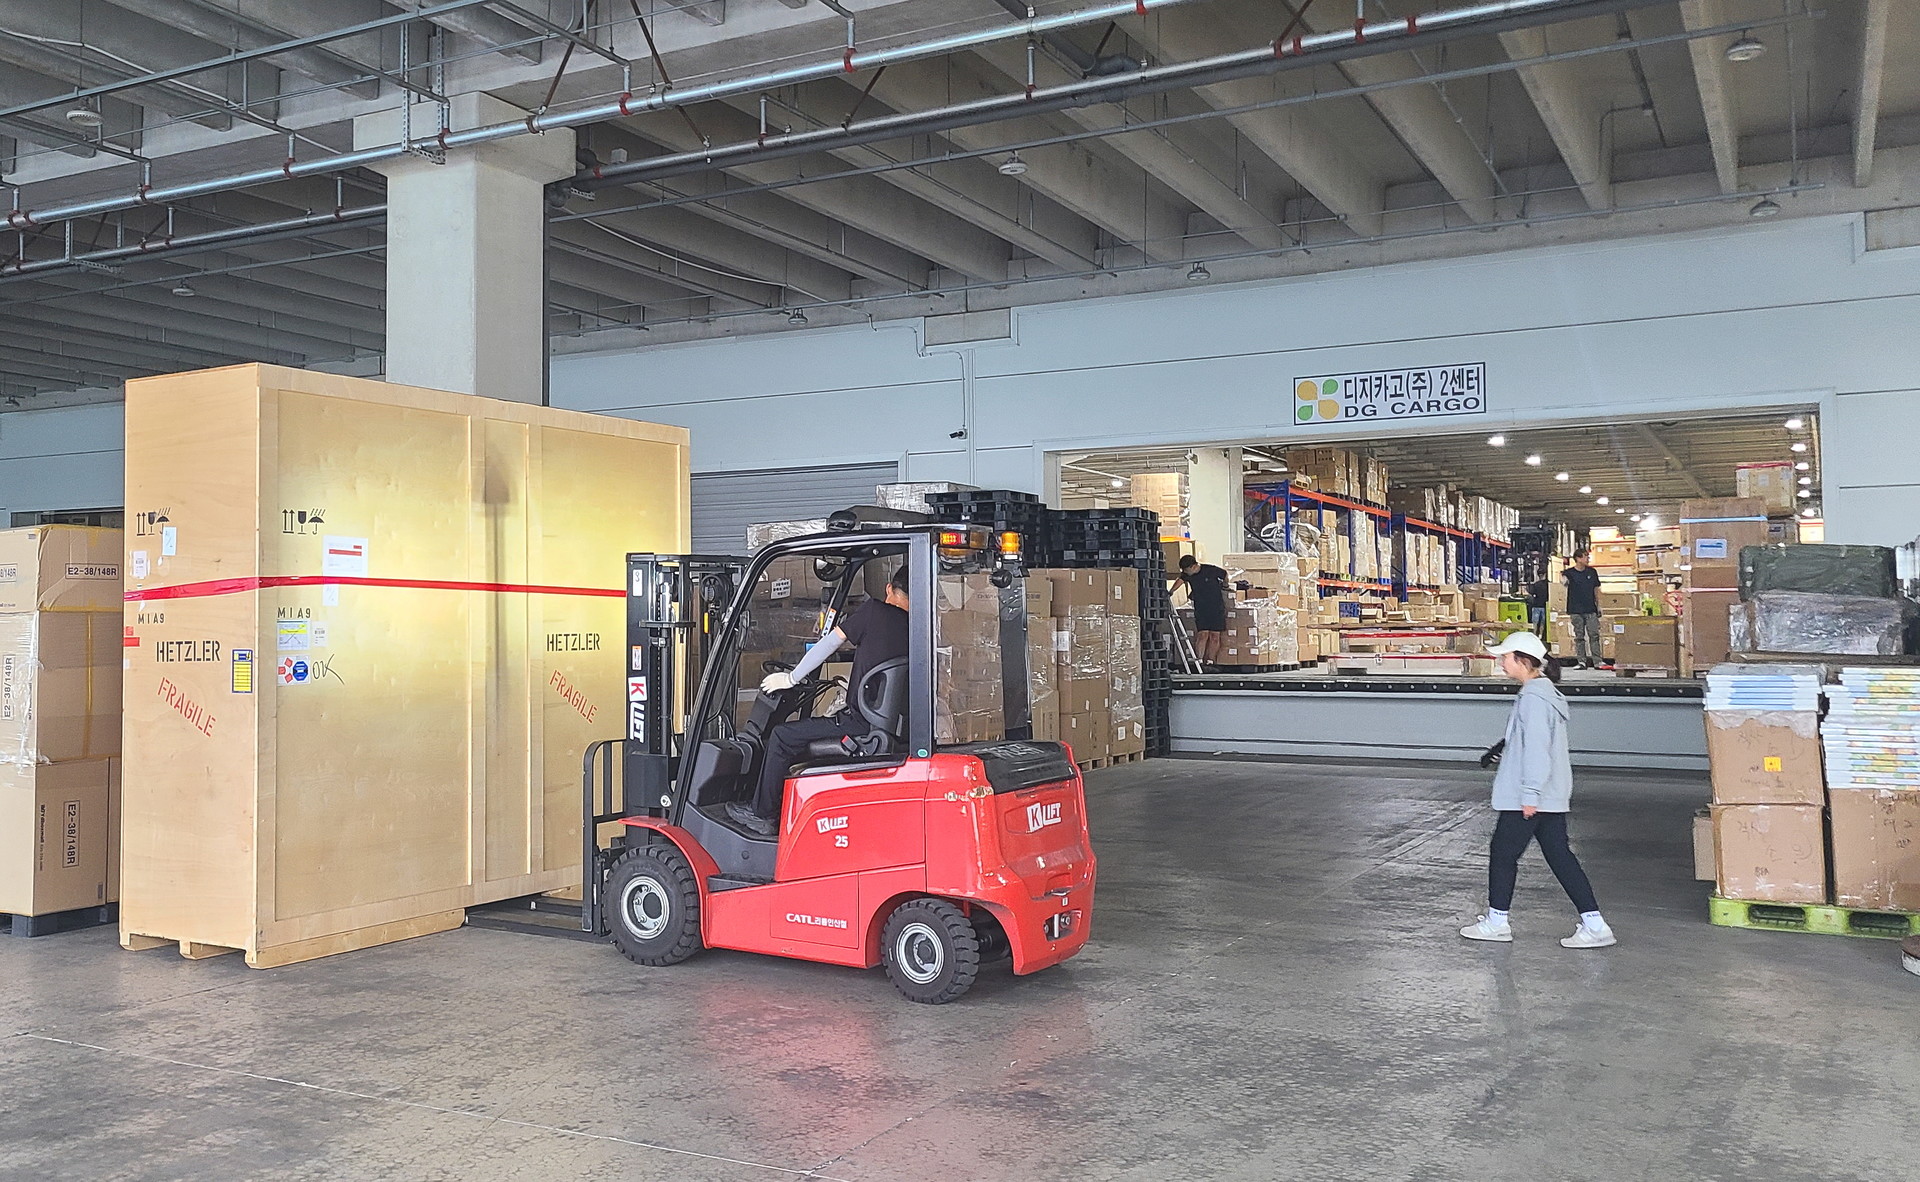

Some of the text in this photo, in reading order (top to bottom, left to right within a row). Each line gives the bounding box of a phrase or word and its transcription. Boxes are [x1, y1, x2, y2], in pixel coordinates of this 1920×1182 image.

[1344, 367, 1480, 403] 디지카고(주) 2센터
[1344, 397, 1480, 418] DG CARGO
[67, 567, 117, 576] E2-38/148R
[156, 640, 221, 662] HETZLER
[546, 633, 601, 651] HETZLER
[157, 676, 217, 738] FRAGILE
[549, 669, 598, 724] FRAGILE
[66, 804, 77, 864] E2-38/148R
[835, 834, 849, 848] 25
